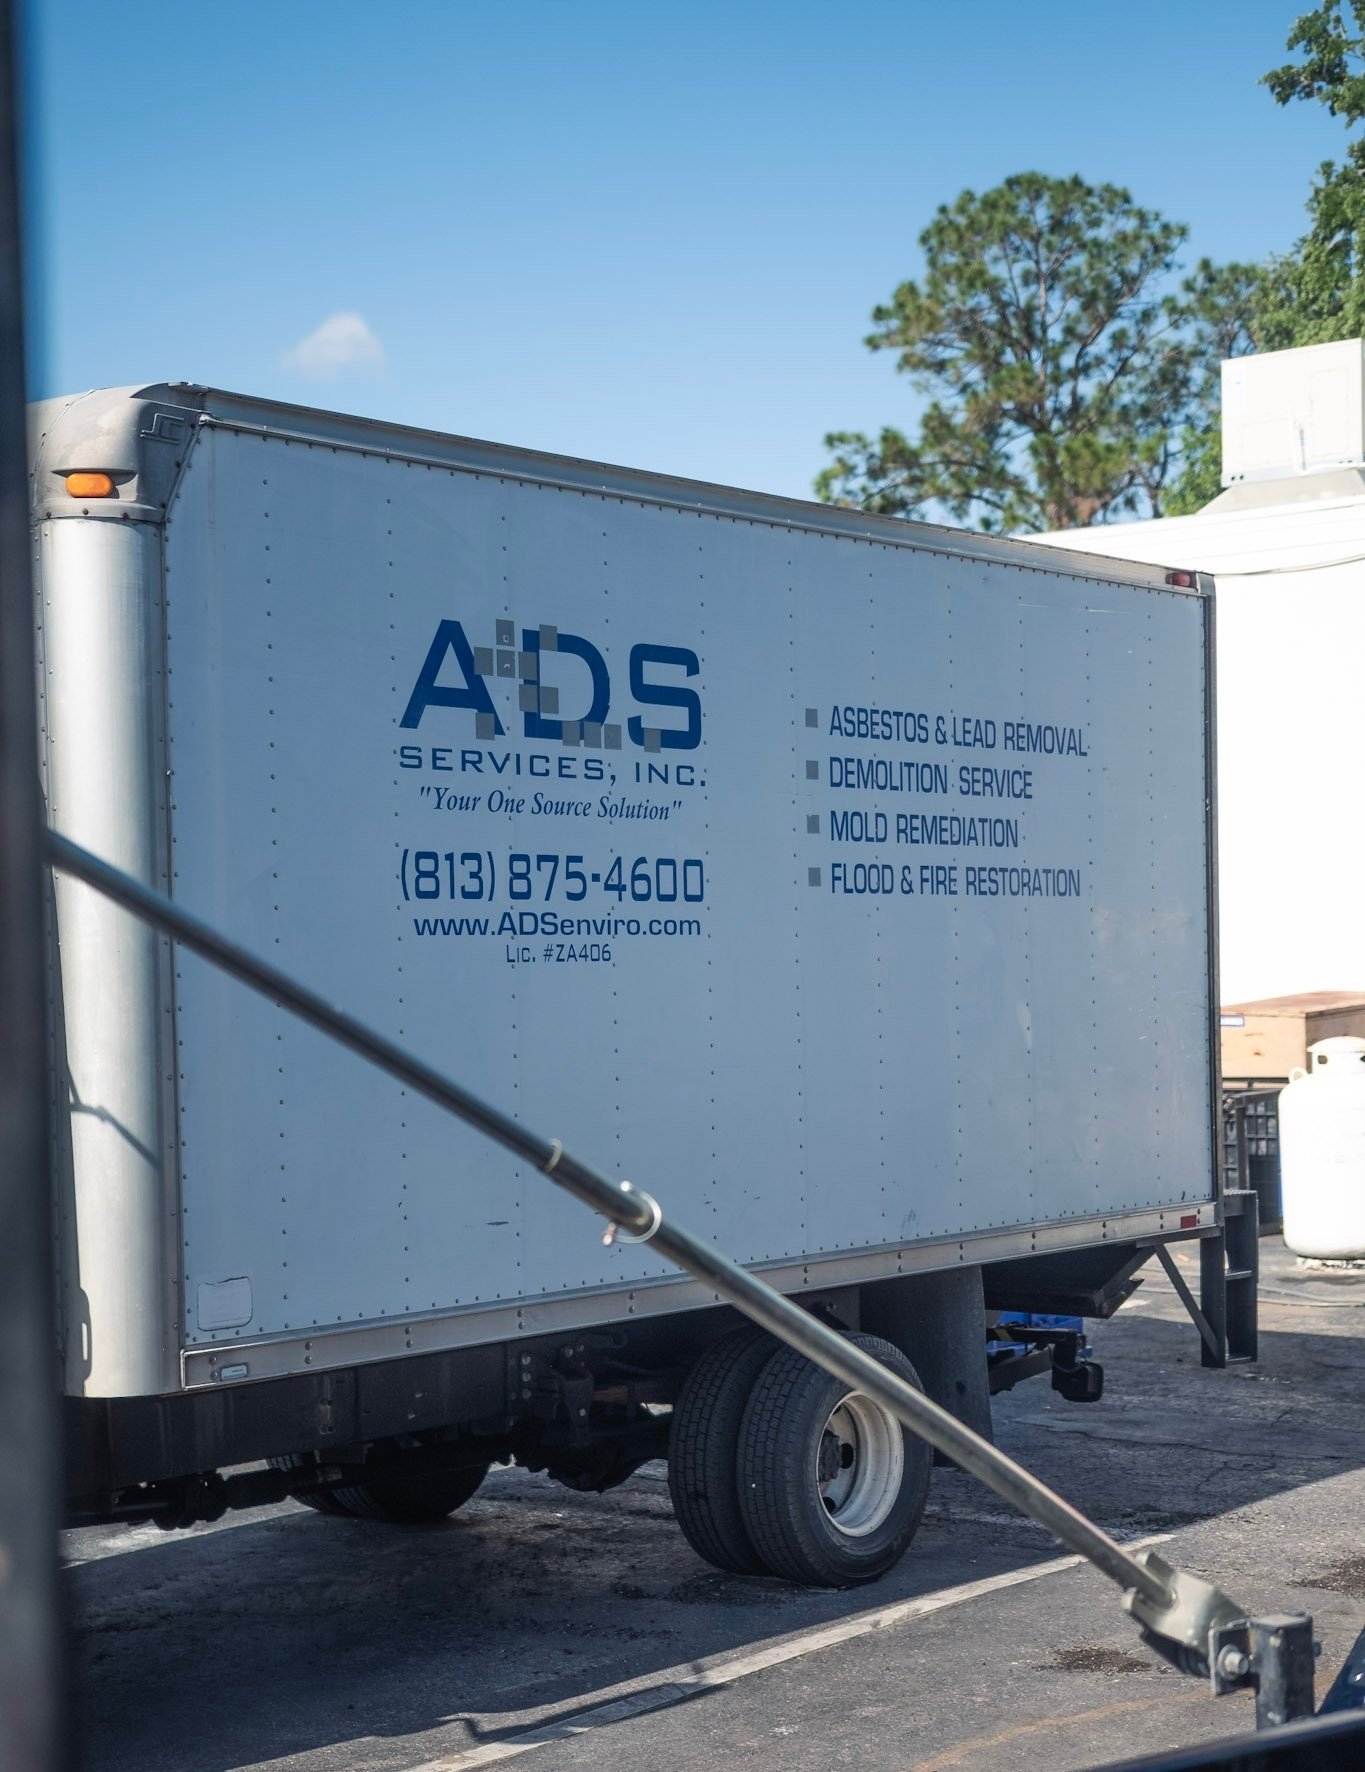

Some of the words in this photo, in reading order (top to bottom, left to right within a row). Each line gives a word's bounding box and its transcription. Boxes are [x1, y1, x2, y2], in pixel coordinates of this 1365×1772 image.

[399, 619, 702, 749] ADS
[829, 705, 929, 744] ASBESTOS
[935, 716, 948, 745] &
[953, 716, 996, 749] LEAD
[1004, 721, 1088, 757] REMOVAL
[399, 745, 617, 787] SERVICES,
[635, 762, 706, 787] INC.
[829, 756, 948, 794] DEMOLITION
[959, 765, 1033, 799] SERVICE
[420, 786, 481, 812] "Your
[487, 790, 525, 814] One
[531, 792, 592, 817] Source
[597, 795, 682, 820] Solution"
[830, 810, 888, 843] MOLD
[896, 813, 1019, 848] REMEDIATION
[400, 849, 496, 902] (813)
[509, 853, 704, 903] 875-4600
[831, 862, 894, 894] FLOOD
[900, 864, 914, 895] &
[920, 865, 958, 895] FIRE
[966, 866, 1081, 897] RESTORATION
[413, 911, 702, 937] www.ADSenviro.com
[543, 943, 612, 963] #ZA406
